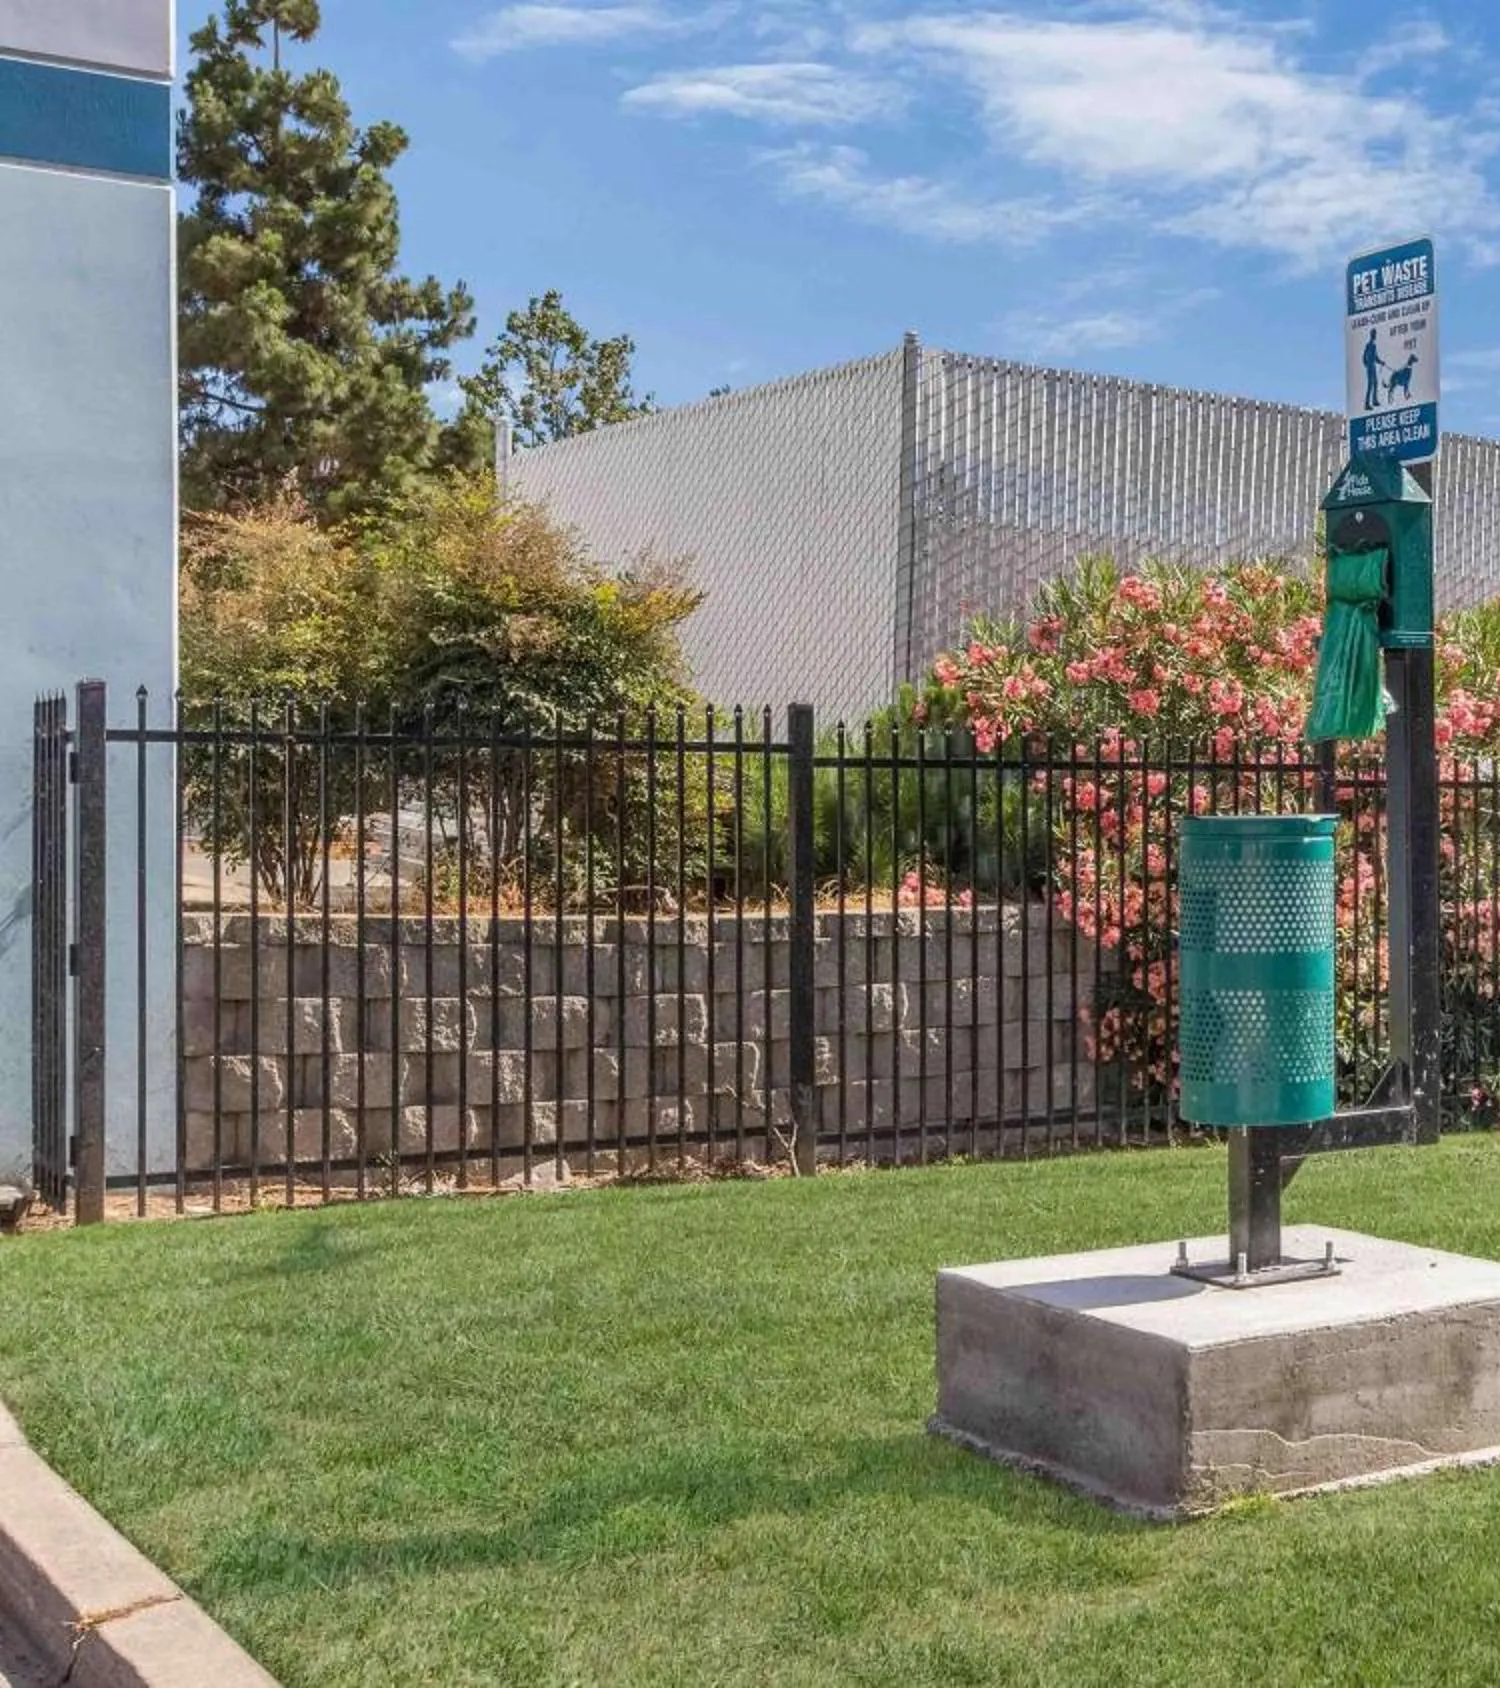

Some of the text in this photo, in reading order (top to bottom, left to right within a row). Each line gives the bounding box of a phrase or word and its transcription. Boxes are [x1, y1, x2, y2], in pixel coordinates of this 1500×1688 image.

[1353, 255, 1428, 295] PET WASTE
[1397, 281, 1428, 300] DISEASE
[1365, 408, 1420, 432] PLEASE KEEP
[1358, 423, 1431, 451] THIS AREA CLEAN
